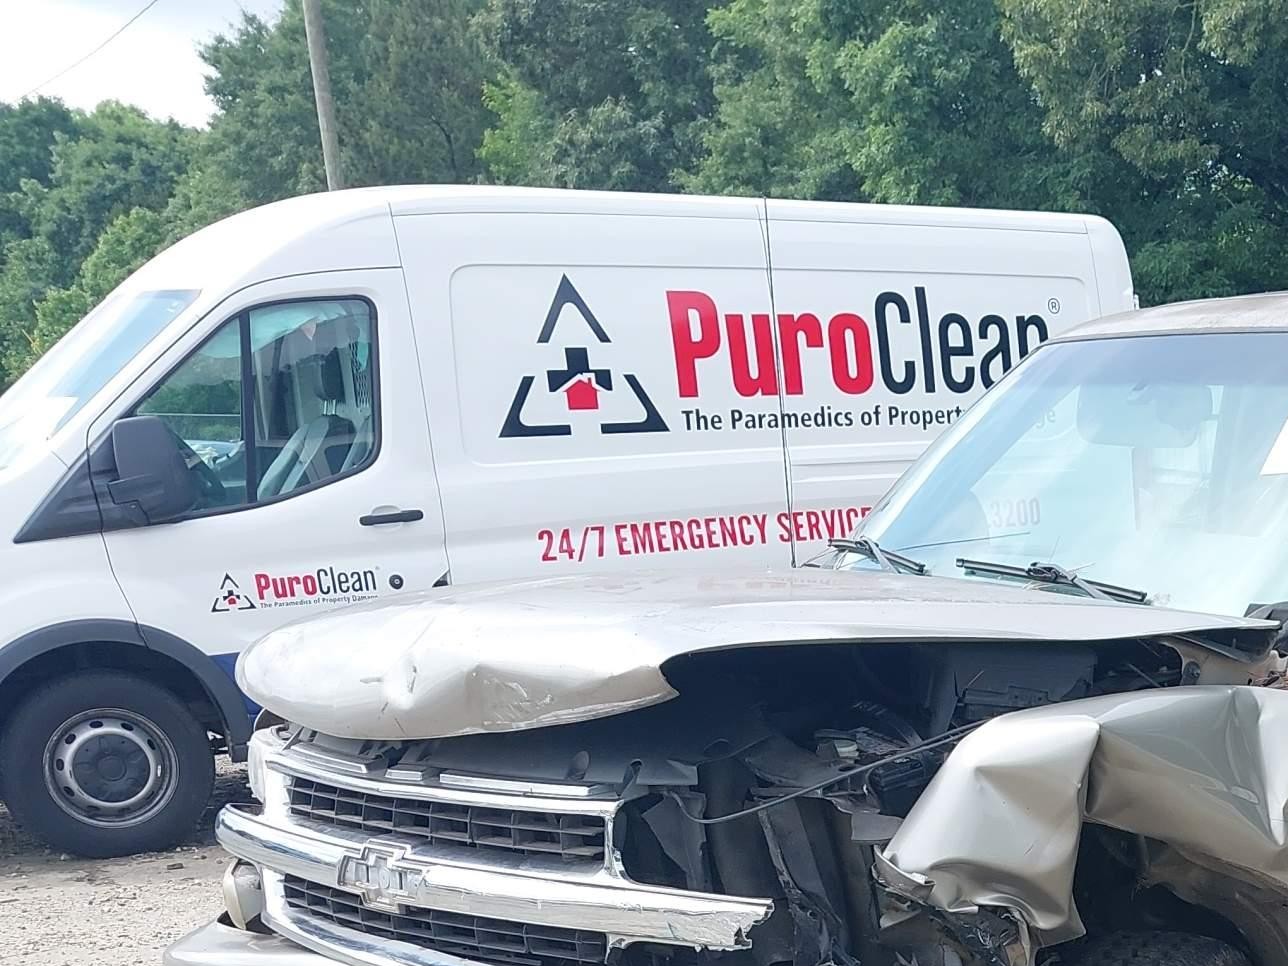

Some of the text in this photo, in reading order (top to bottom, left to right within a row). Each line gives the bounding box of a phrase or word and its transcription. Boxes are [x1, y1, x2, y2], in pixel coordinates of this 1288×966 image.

[680, 404, 967, 431] The Paramedics of Propert
[537, 526, 606, 562] 24/7
[614, 514, 768, 556] EMERGENCY
[254, 566, 377, 600] PuroClean
[274, 599, 312, 608] Paramedics
[322, 595, 350, 605] Property
